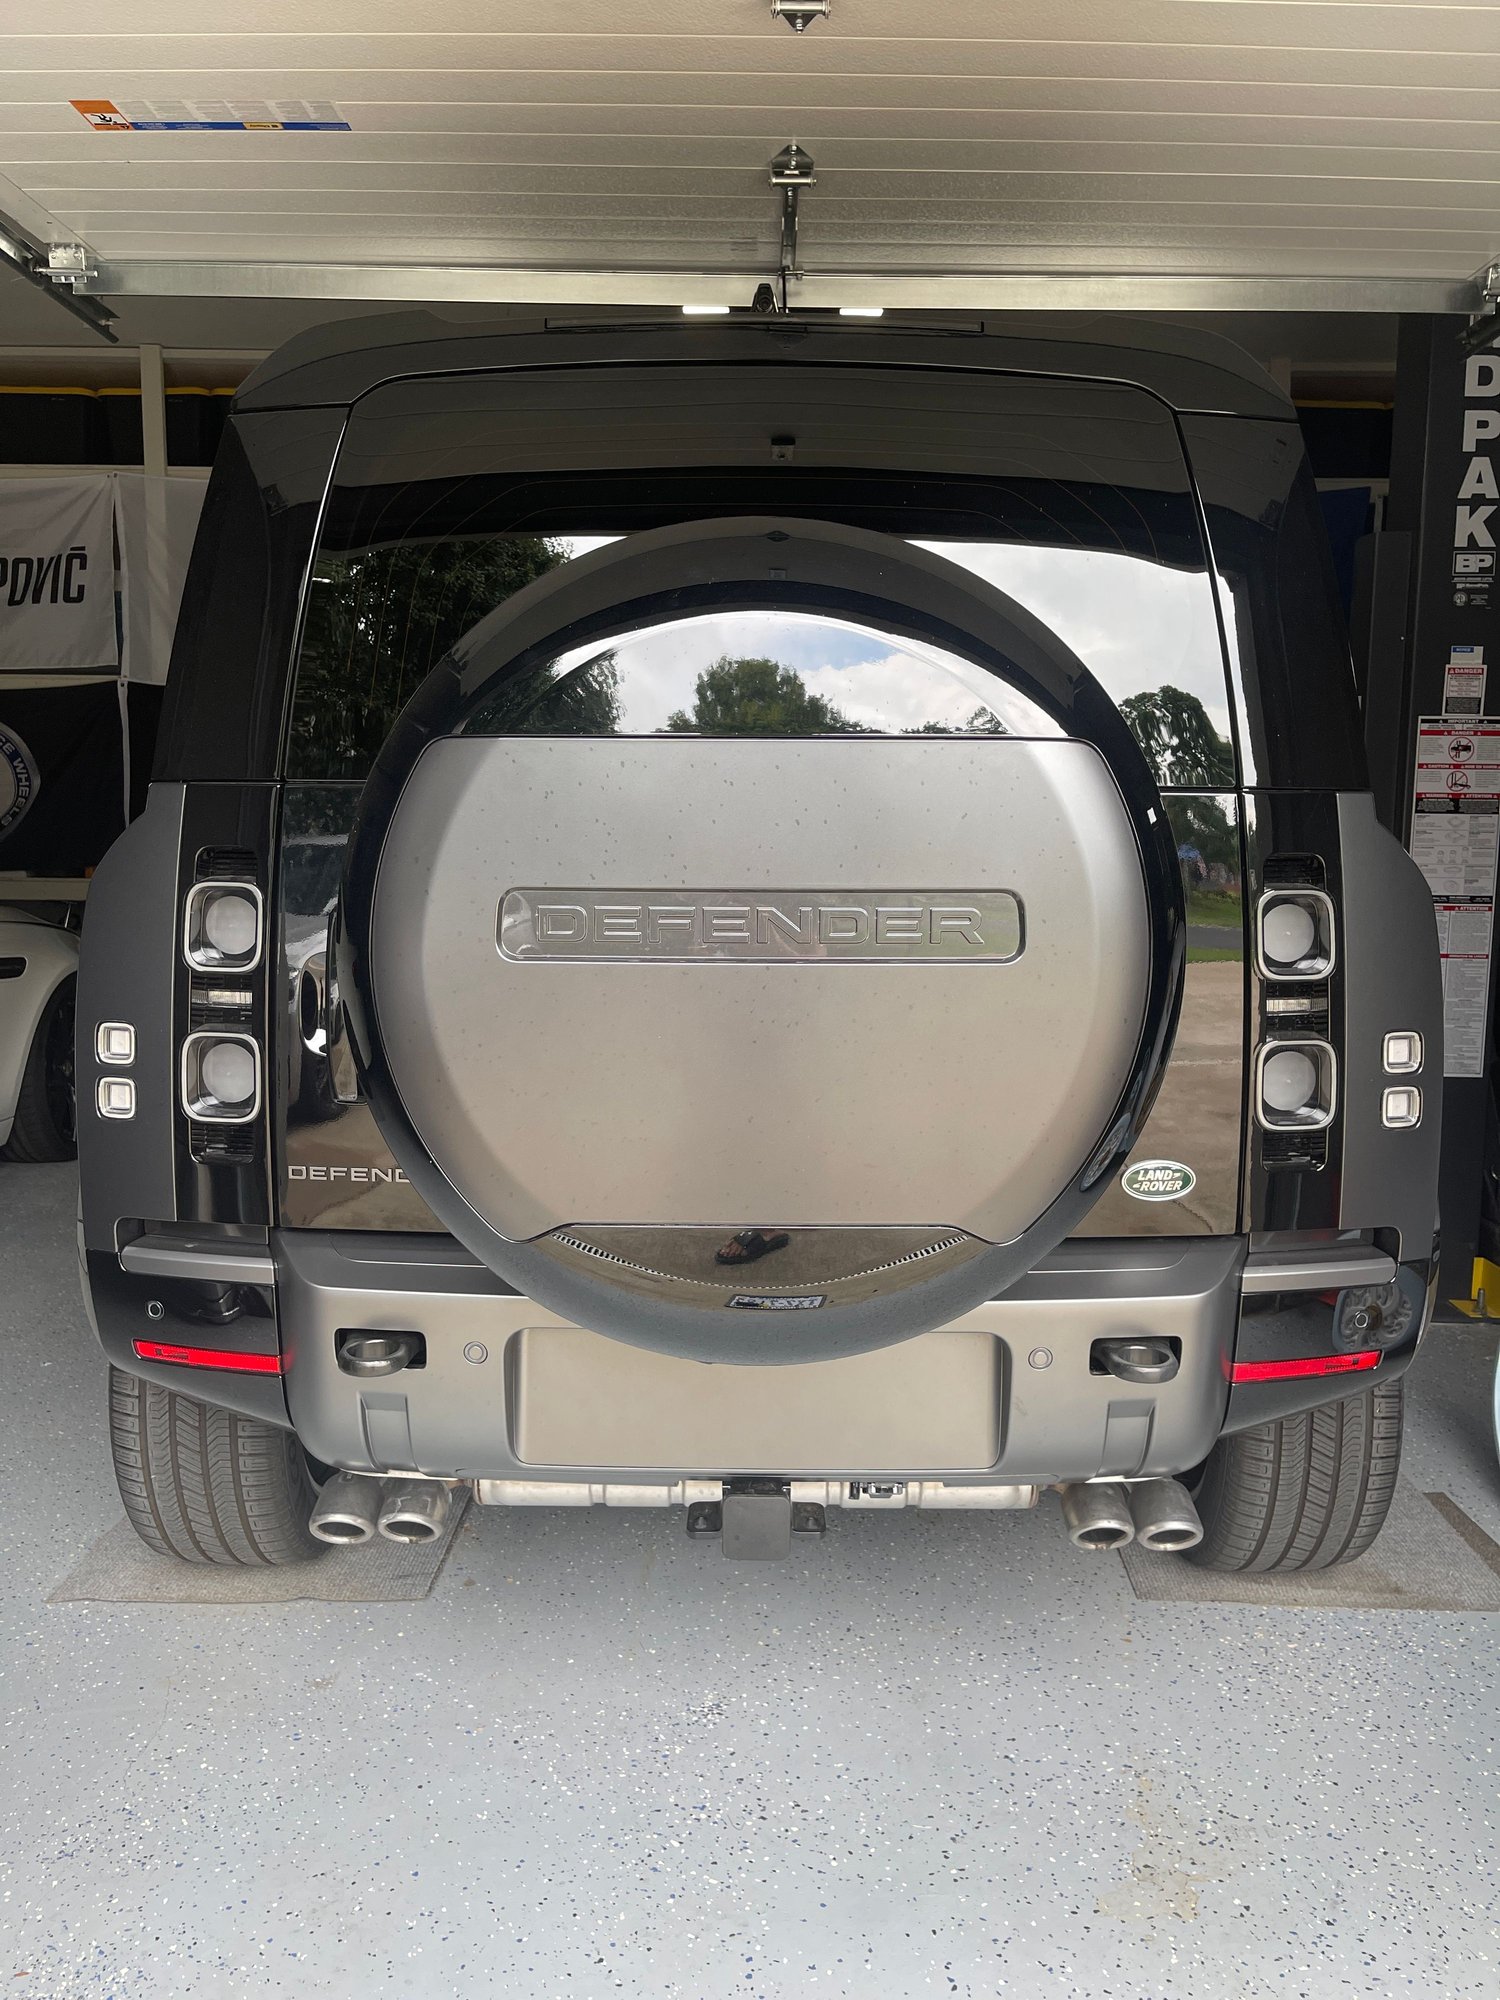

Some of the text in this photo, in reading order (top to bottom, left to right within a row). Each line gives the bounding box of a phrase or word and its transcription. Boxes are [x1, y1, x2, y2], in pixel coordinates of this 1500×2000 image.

[1453, 336, 1500, 548] DPAK
[1455, 554, 1493, 573] BP
[1, 757, 30, 826] WHEELS
[536, 904, 985, 946] DEFENDER
[1137, 1169, 1173, 1181] LAND
[1139, 1181, 1183, 1192] ROVER
